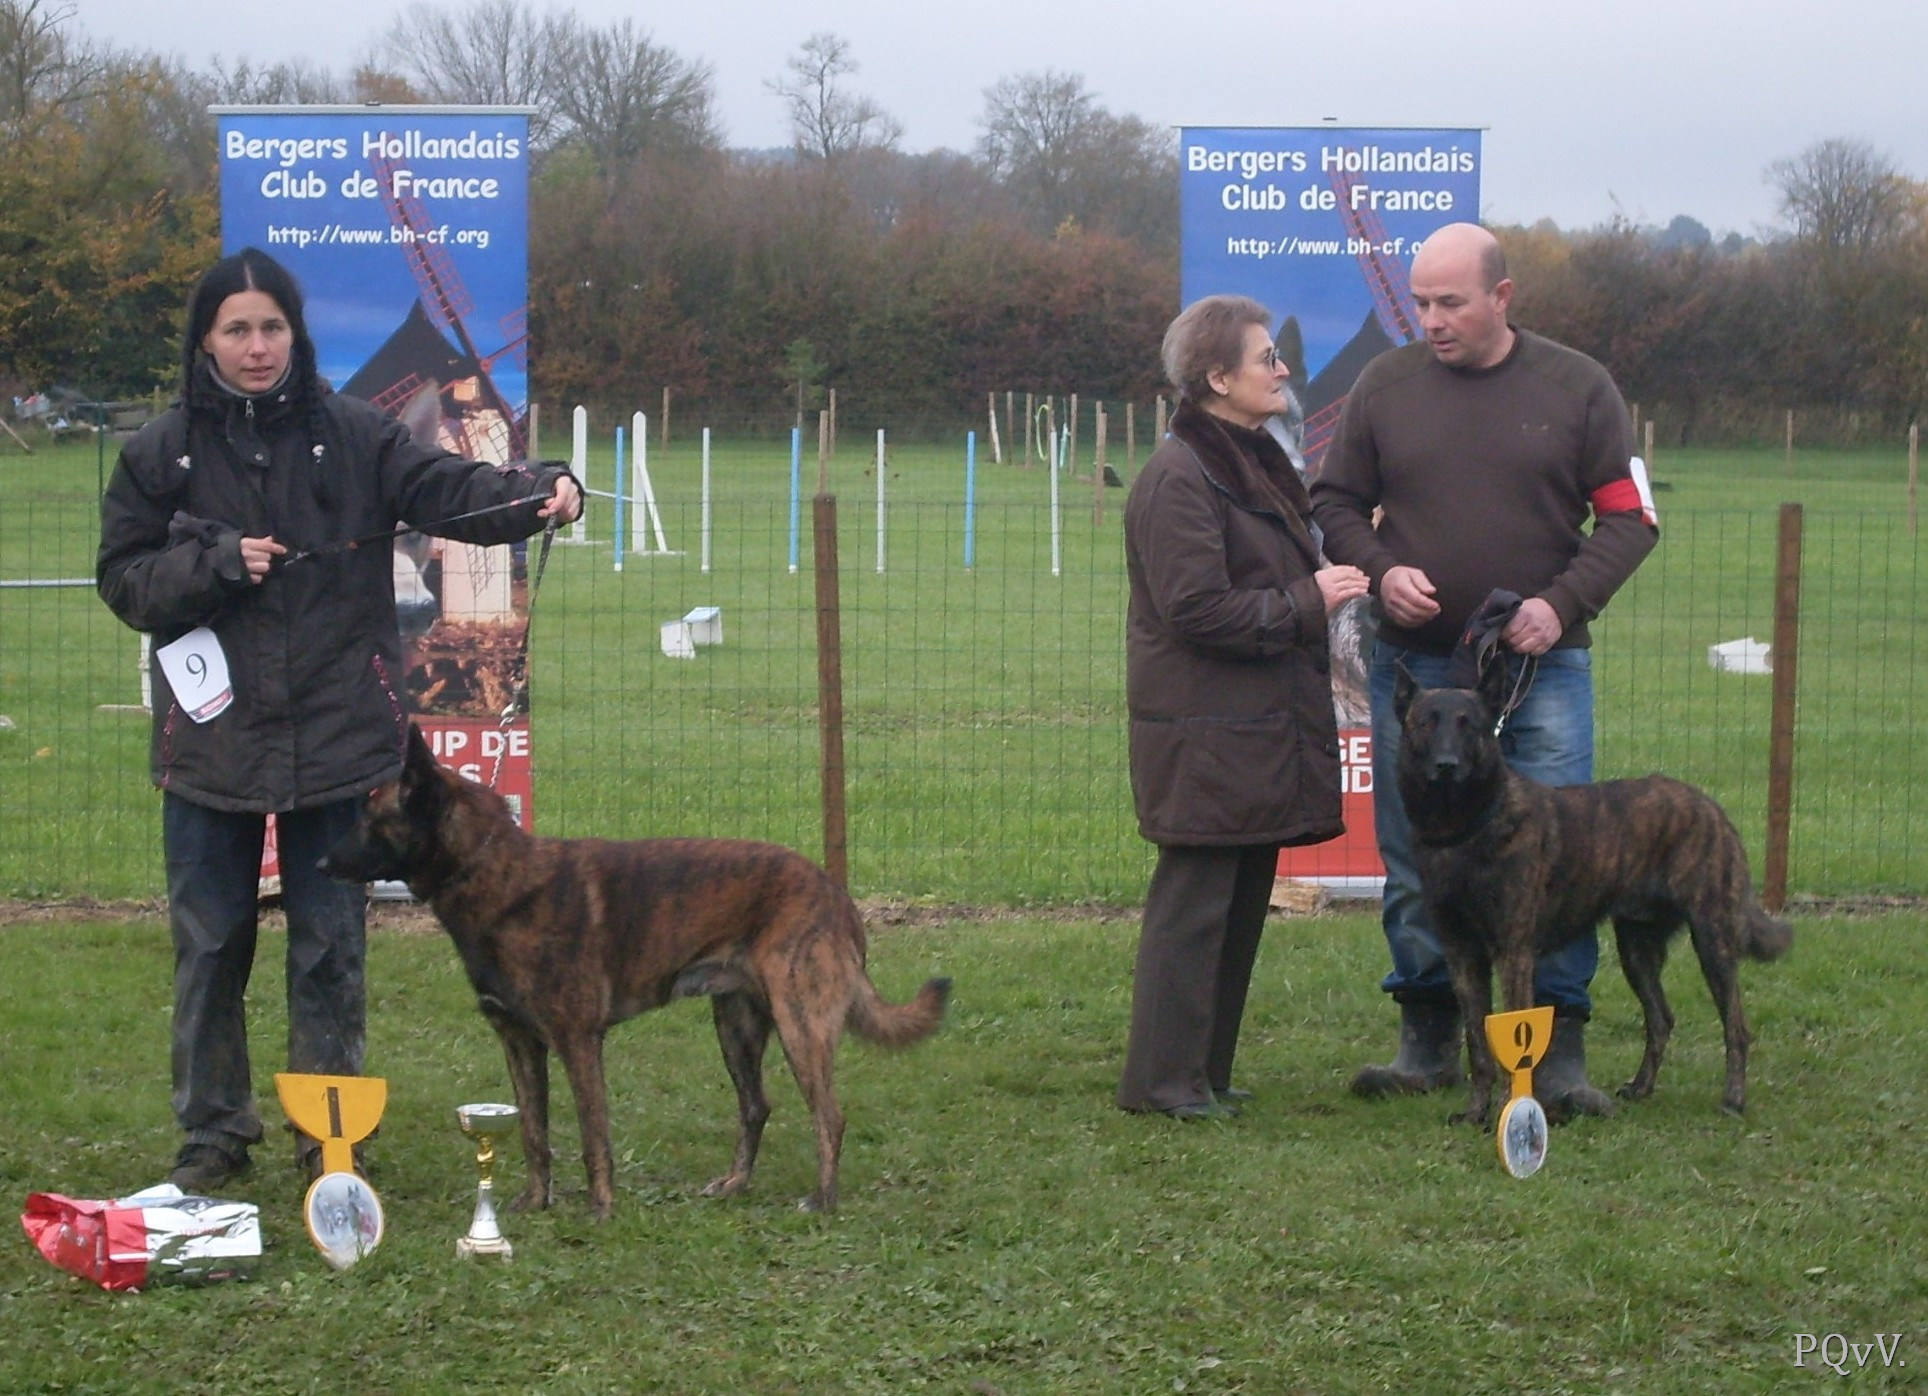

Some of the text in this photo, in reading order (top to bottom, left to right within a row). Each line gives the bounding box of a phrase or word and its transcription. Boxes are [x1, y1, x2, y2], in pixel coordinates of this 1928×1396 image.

[226, 130, 521, 167] Bergers Hollandais
[1187, 145, 1475, 179] Bergers Hollandais
[260, 170, 499, 198] Club de France
[1221, 184, 1454, 211] Club de France
[267, 224, 490, 249] http://www.bh-cf.org
[1227, 236, 1422, 259] http://www.bh-cf.o
[185, 652, 207, 689] 9
[481, 729, 529, 757] DE
